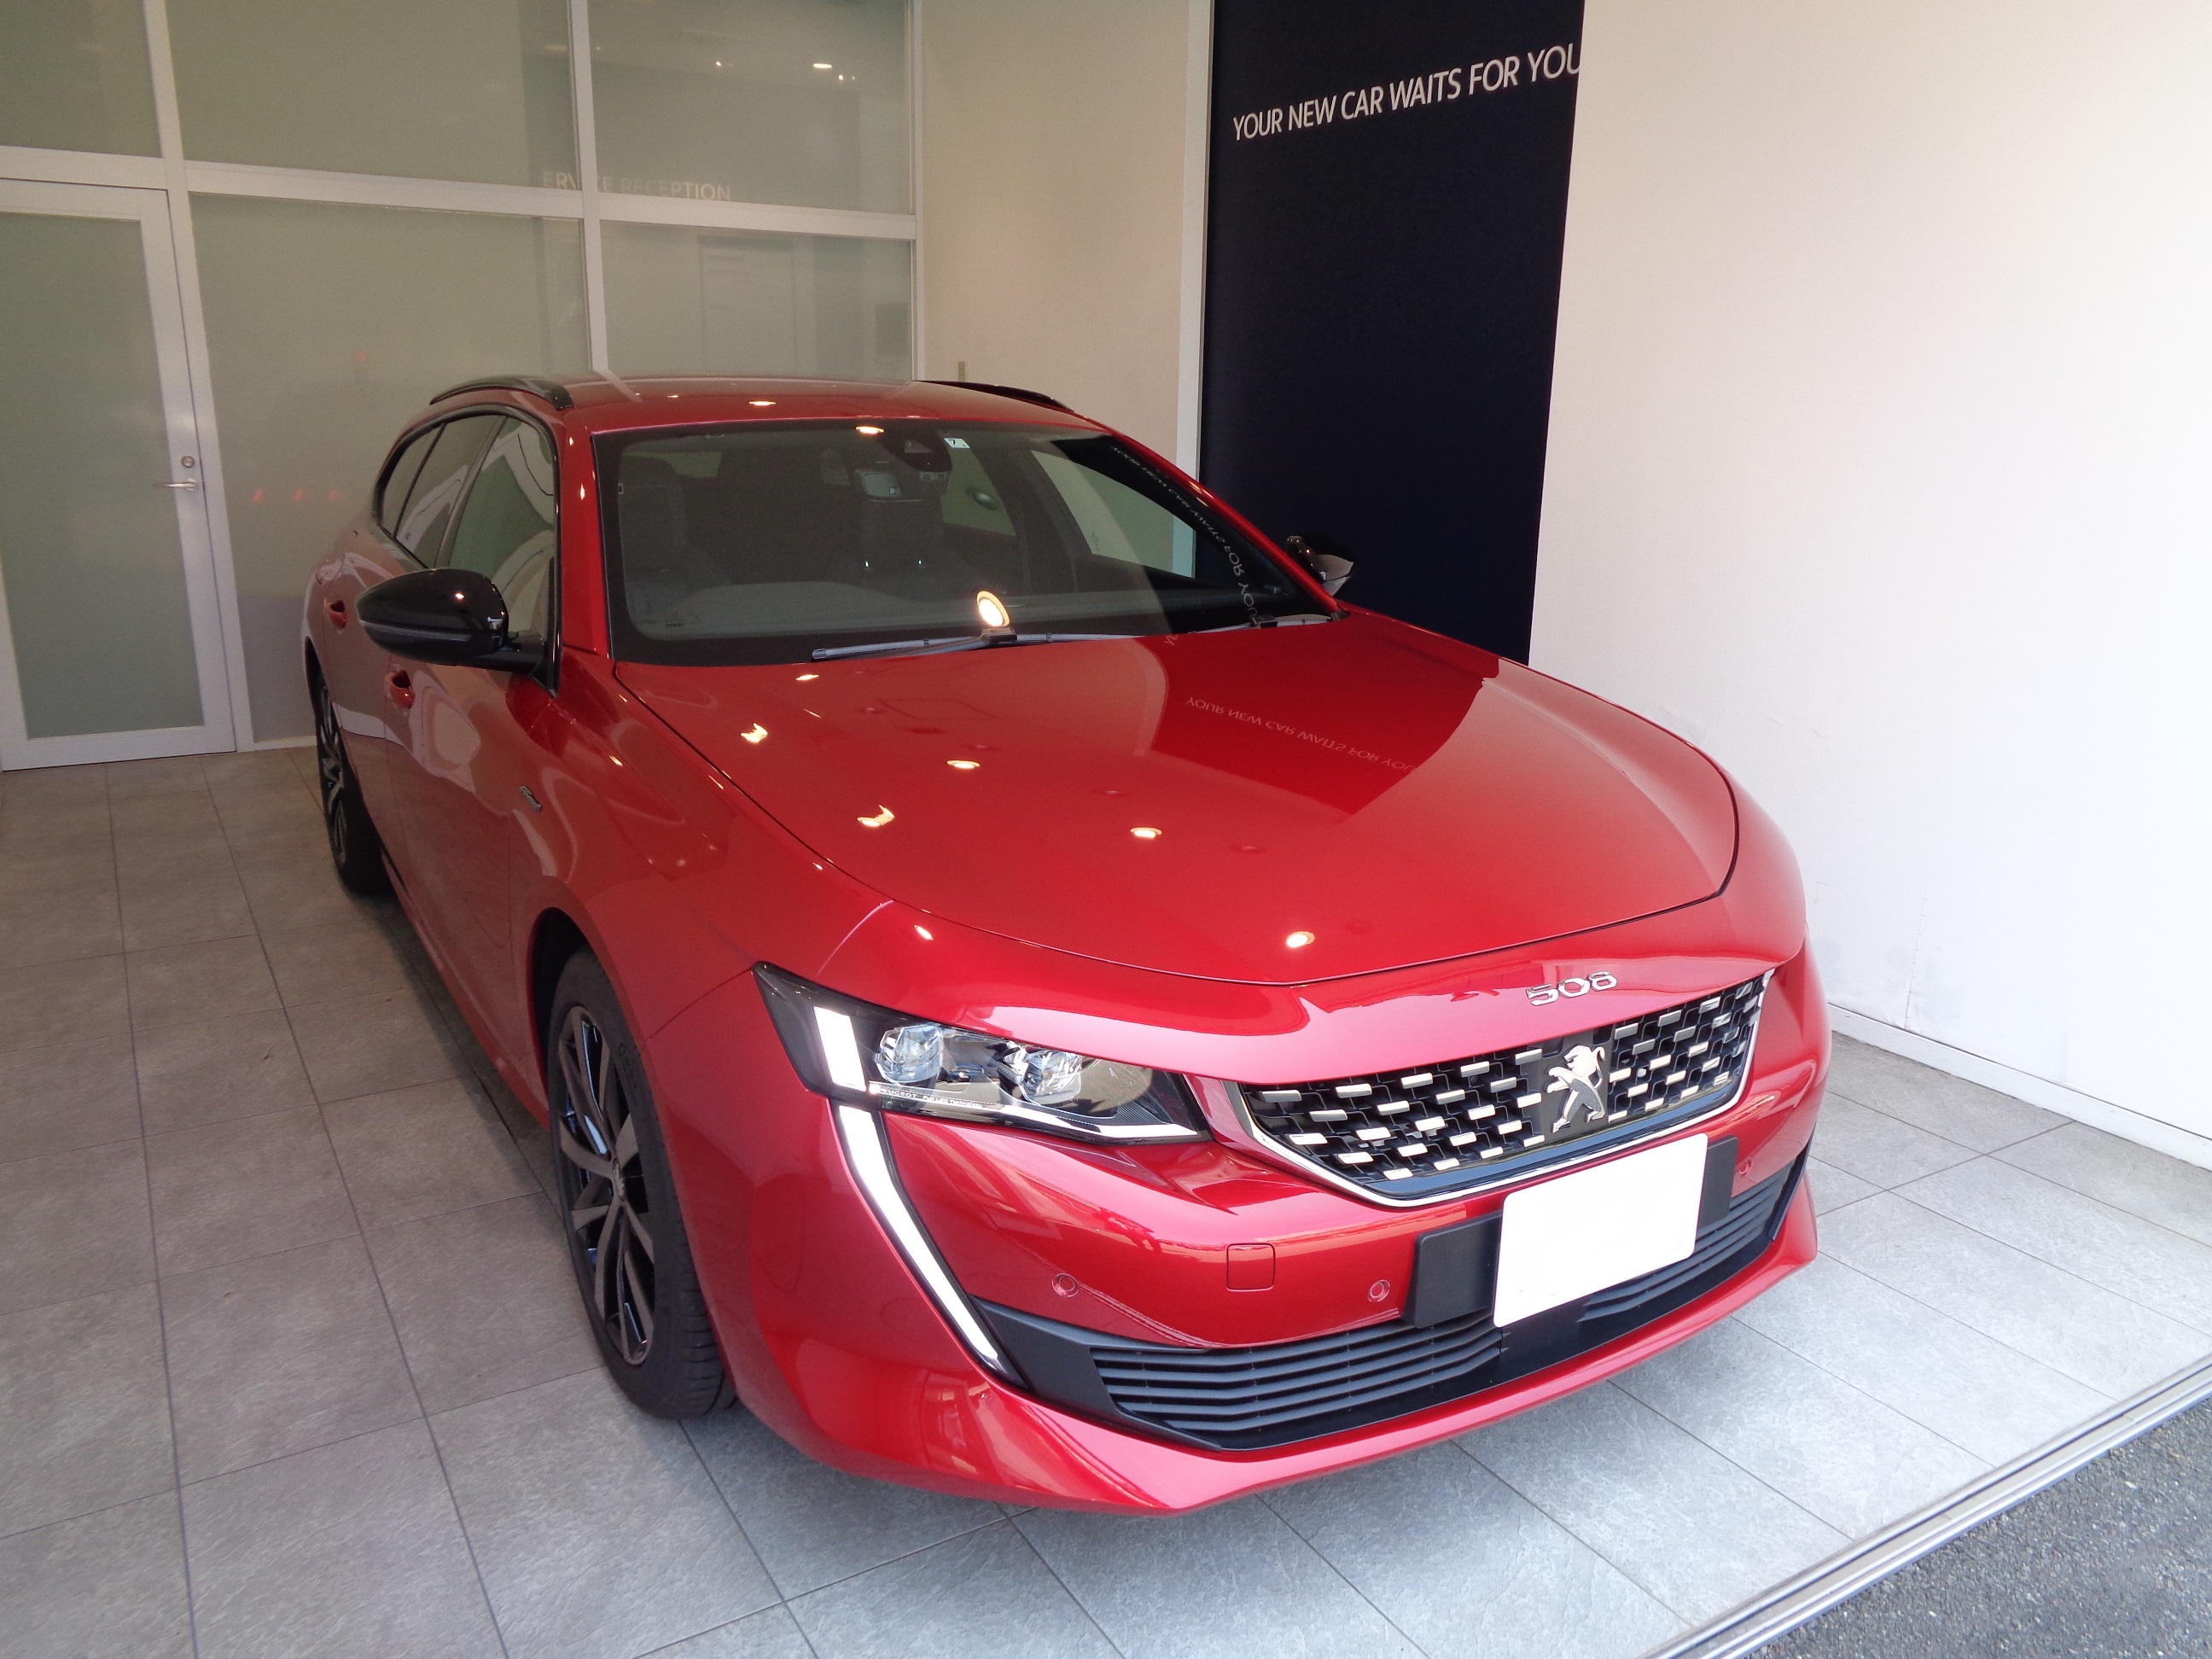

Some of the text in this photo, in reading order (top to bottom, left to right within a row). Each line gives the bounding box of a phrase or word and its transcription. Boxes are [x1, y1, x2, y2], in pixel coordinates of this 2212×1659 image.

[1233, 44, 1580, 140] YOUR NEW CAR WAITS FOR YOU
[620, 177, 731, 201] RECEPTION
[1526, 971, 1617, 1006] 508
